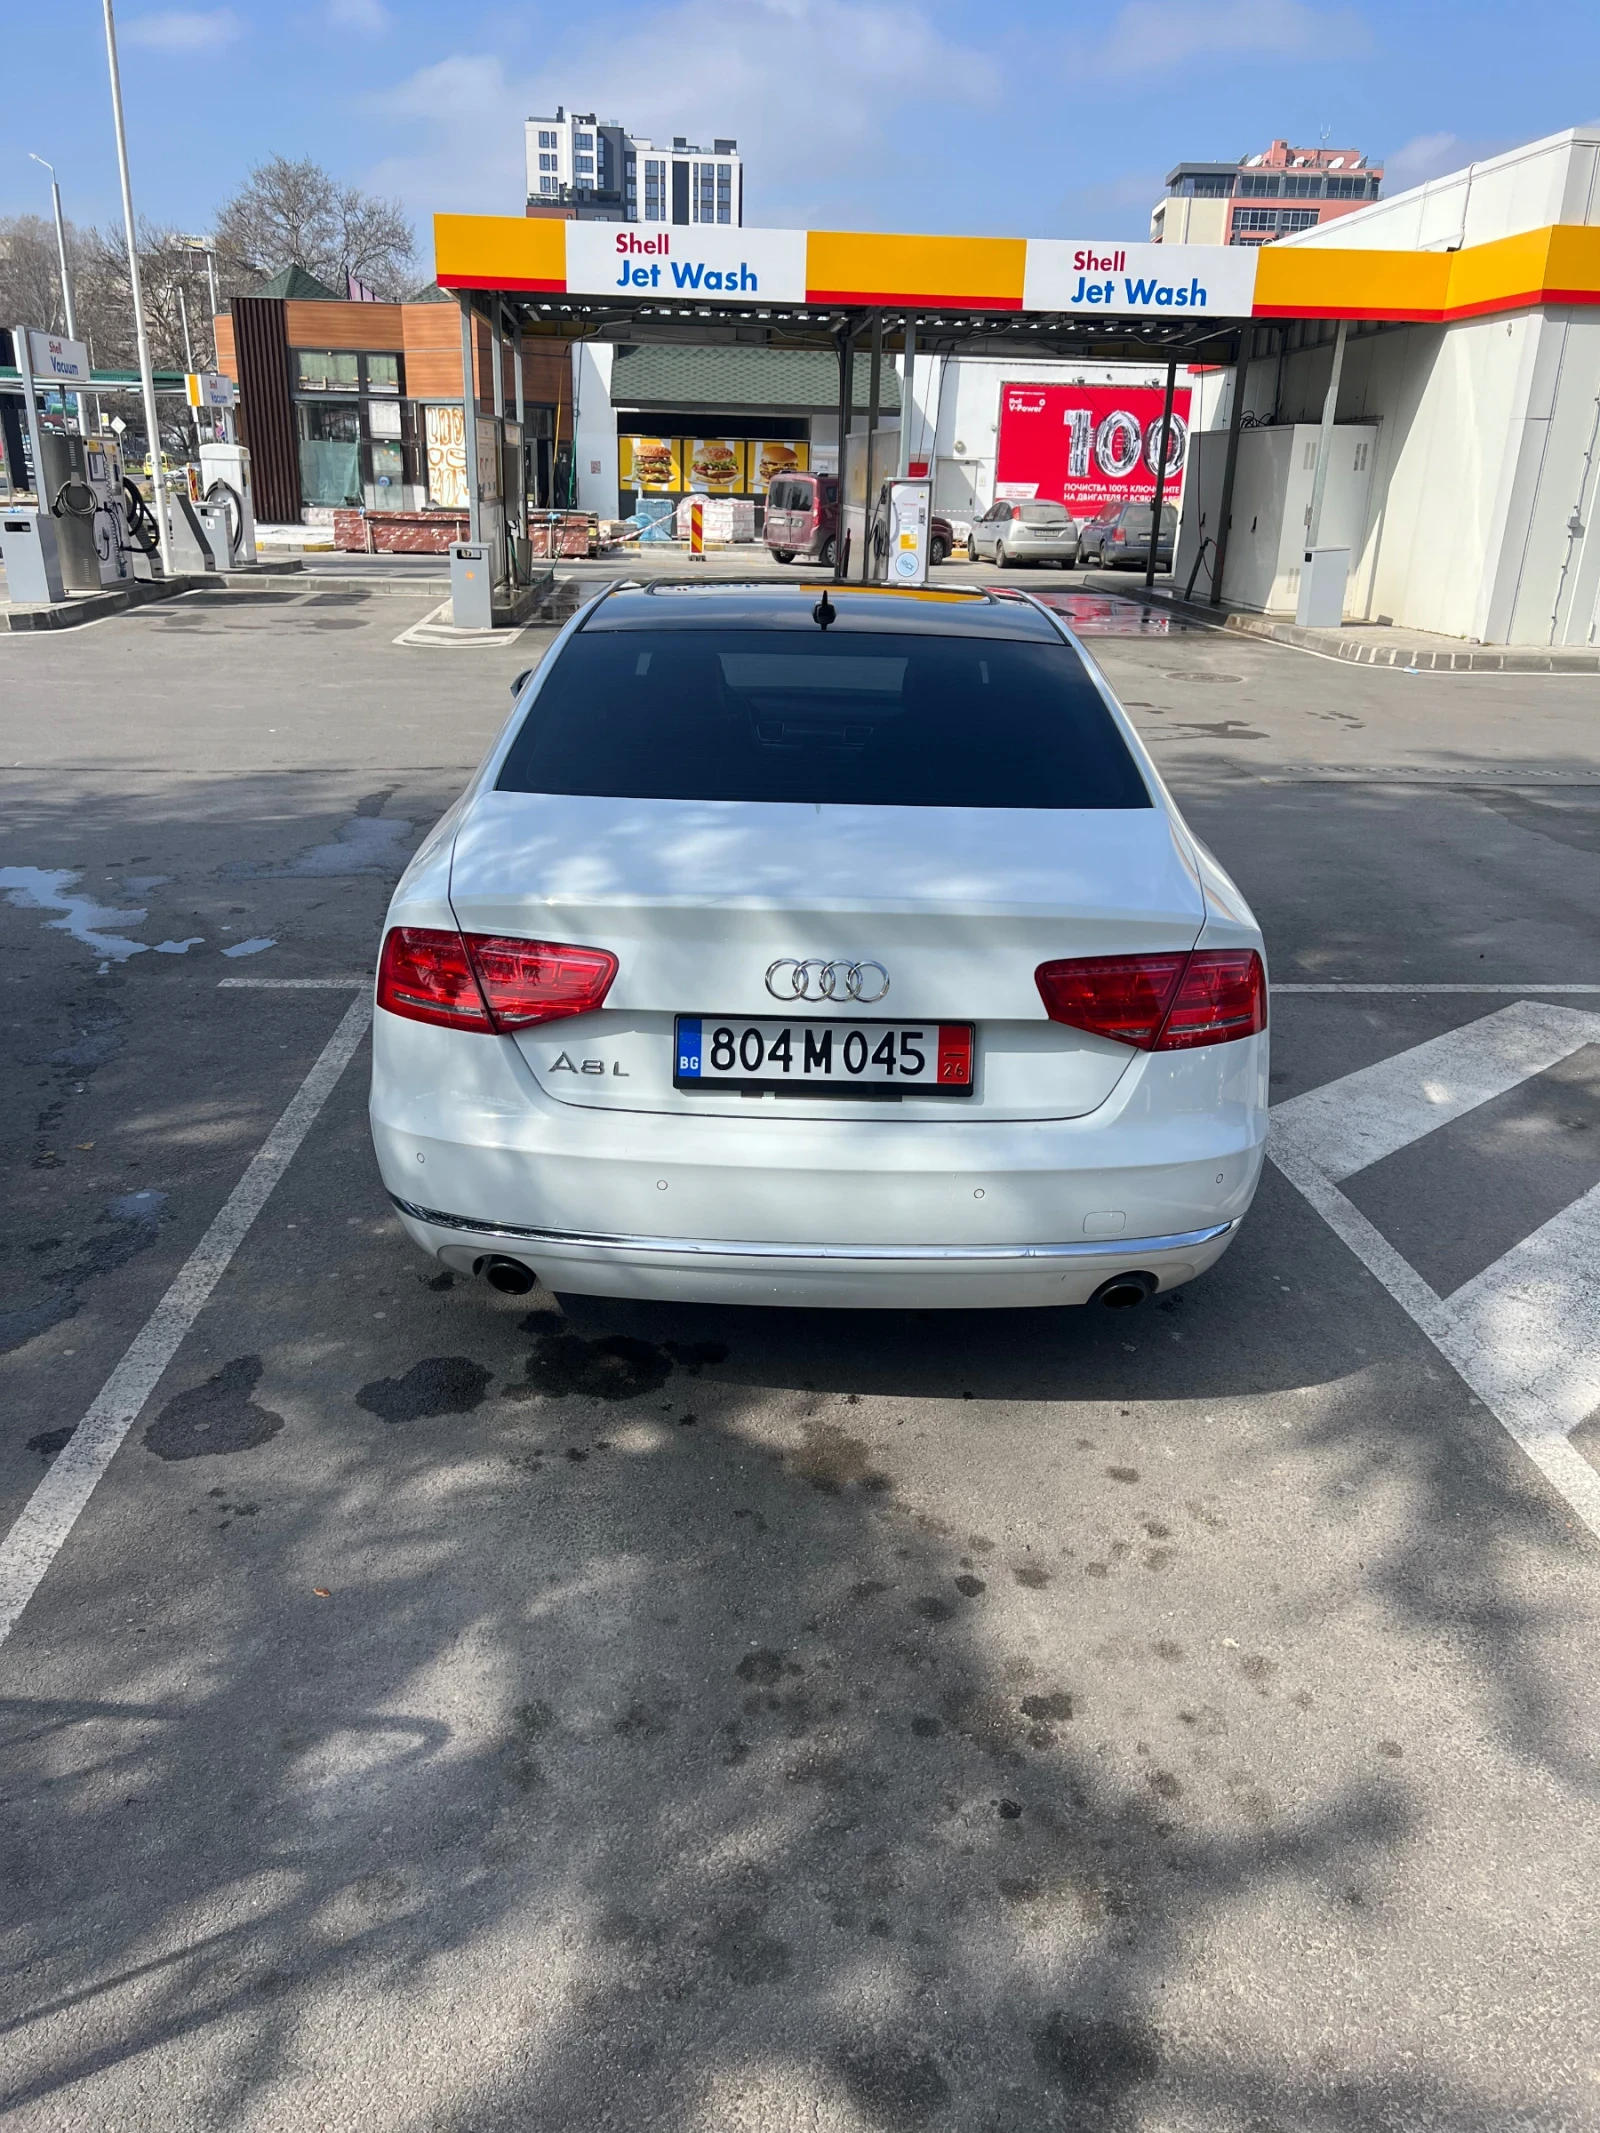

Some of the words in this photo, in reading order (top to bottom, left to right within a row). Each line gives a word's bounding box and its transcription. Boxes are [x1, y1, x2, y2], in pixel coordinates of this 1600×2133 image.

[616, 232, 669, 255] Shell
[1073, 250, 1126, 272] Shell
[616, 260, 661, 287] Jet
[670, 262, 758, 291] Wash
[1071, 277, 1115, 304] Jet
[1124, 278, 1207, 306] Wash
[48, 340, 63, 355] Shell
[50, 355, 79, 376] Vacuum
[210, 391, 229, 404] Vacuum
[1009, 403, 1043, 413] V-Power
[1063, 409, 1187, 478] 100
[1063, 493, 1076, 501] НА
[1076, 493, 1121, 502] ДВИГАТЕЛЯ
[1122, 494, 1129, 502] С
[1064, 483, 1107, 492] ПОЧИСТВА
[1108, 484, 1129, 492] 100%
[680, 1056, 699, 1070] BG
[943, 1062, 965, 1078] 26
